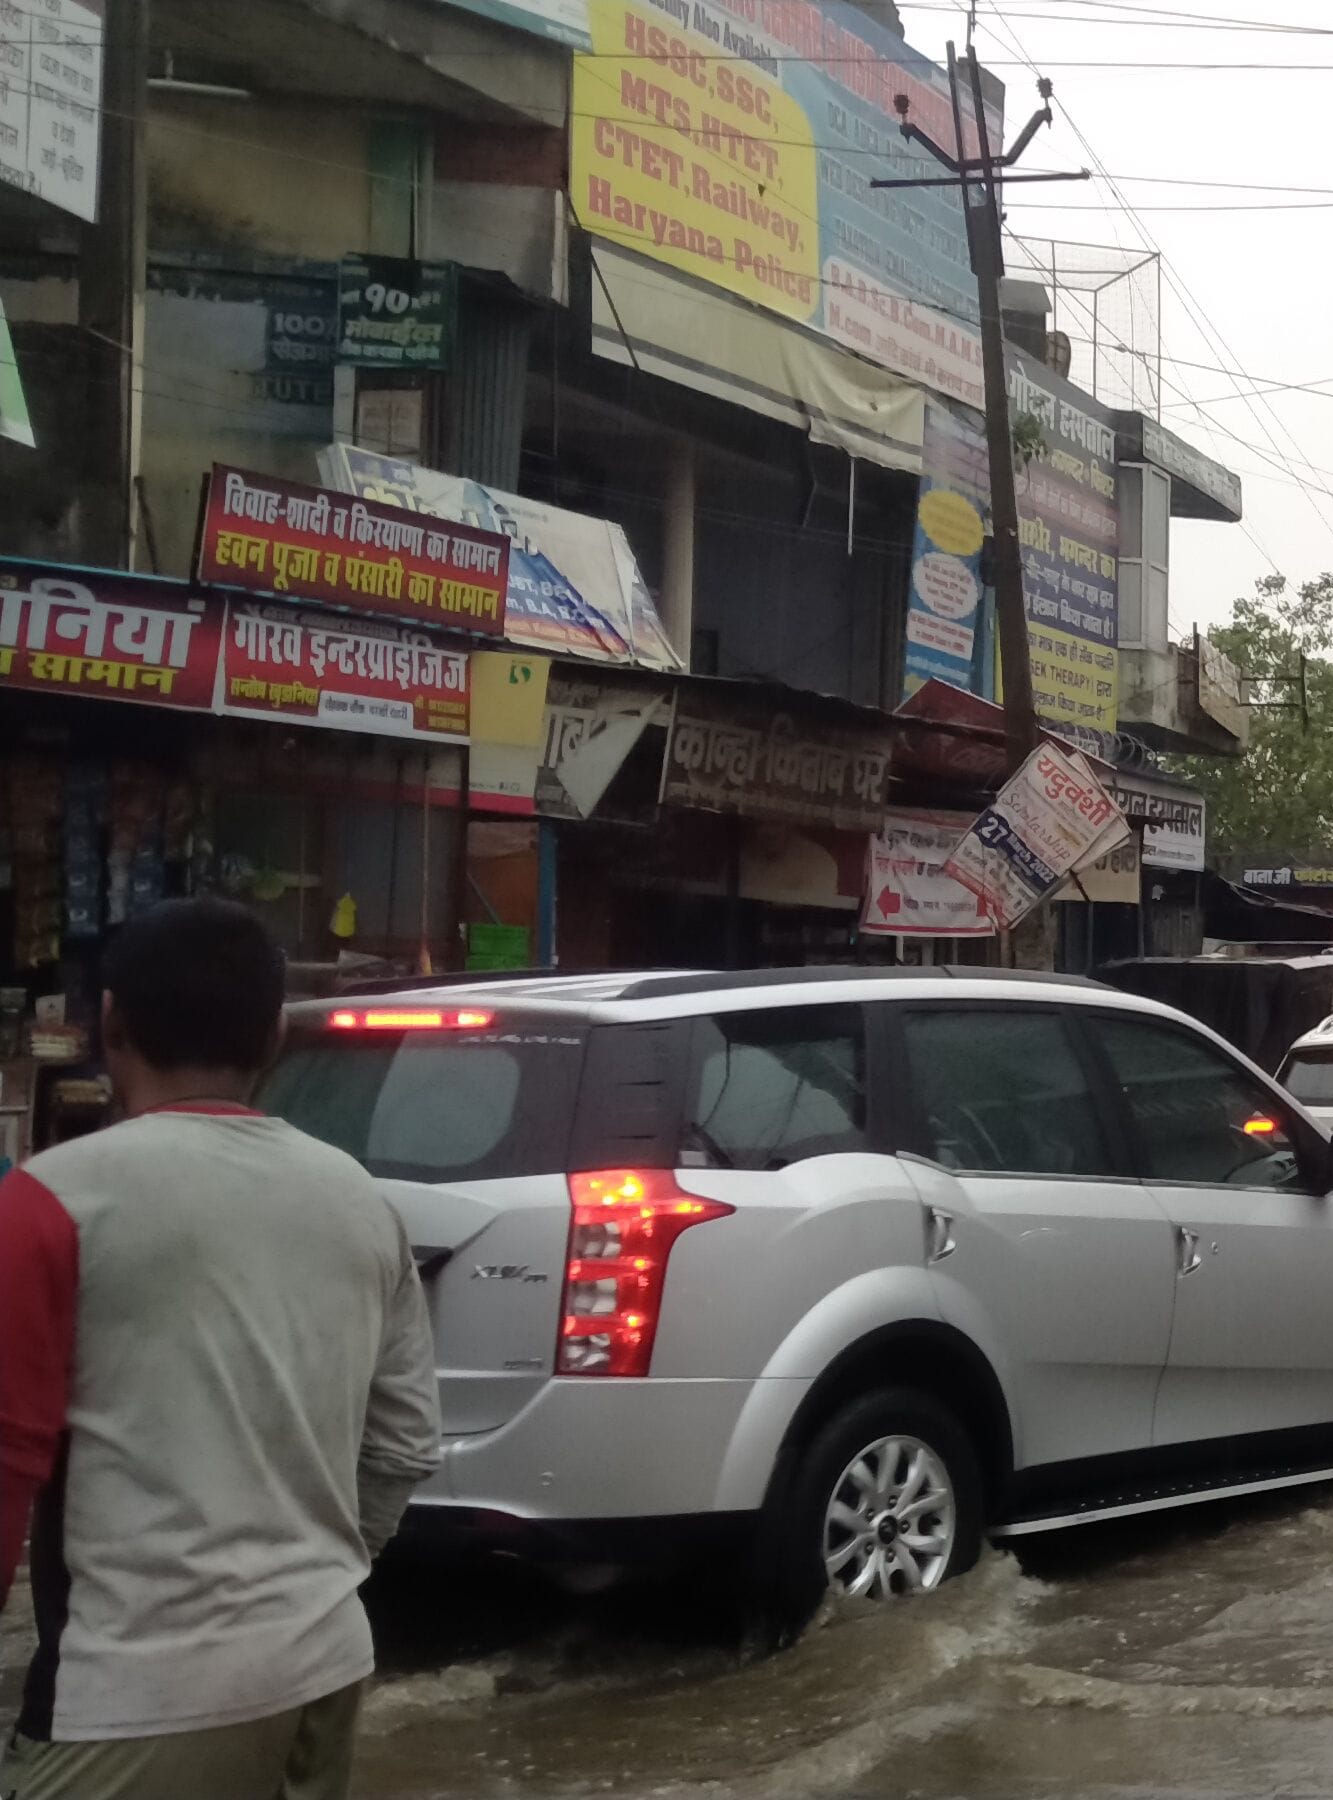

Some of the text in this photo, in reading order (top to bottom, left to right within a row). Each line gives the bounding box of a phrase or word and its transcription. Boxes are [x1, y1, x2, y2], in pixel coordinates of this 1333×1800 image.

[587, 173, 725, 265] Haryana
[734, 237, 812, 306] Police
[365, 283, 410, 314] 90
[224, 473, 331, 536] विवाह-शादी
[333, 506, 349, 539] व
[427, 530, 449, 564] का
[452, 536, 502, 576] सामान
[216, 530, 269, 572] हवन
[272, 541, 321, 592] पूजा
[324, 552, 342, 587] व
[345, 551, 405, 601] पंसारी
[408, 570, 436, 606] का
[439, 577, 500, 620] सामान
[28, 651, 178, 695] सामान
[1036, 753, 1114, 827] यदुवंशी
[978, 815, 1010, 844] 27
[1243, 867, 1291, 885] बालाजी
